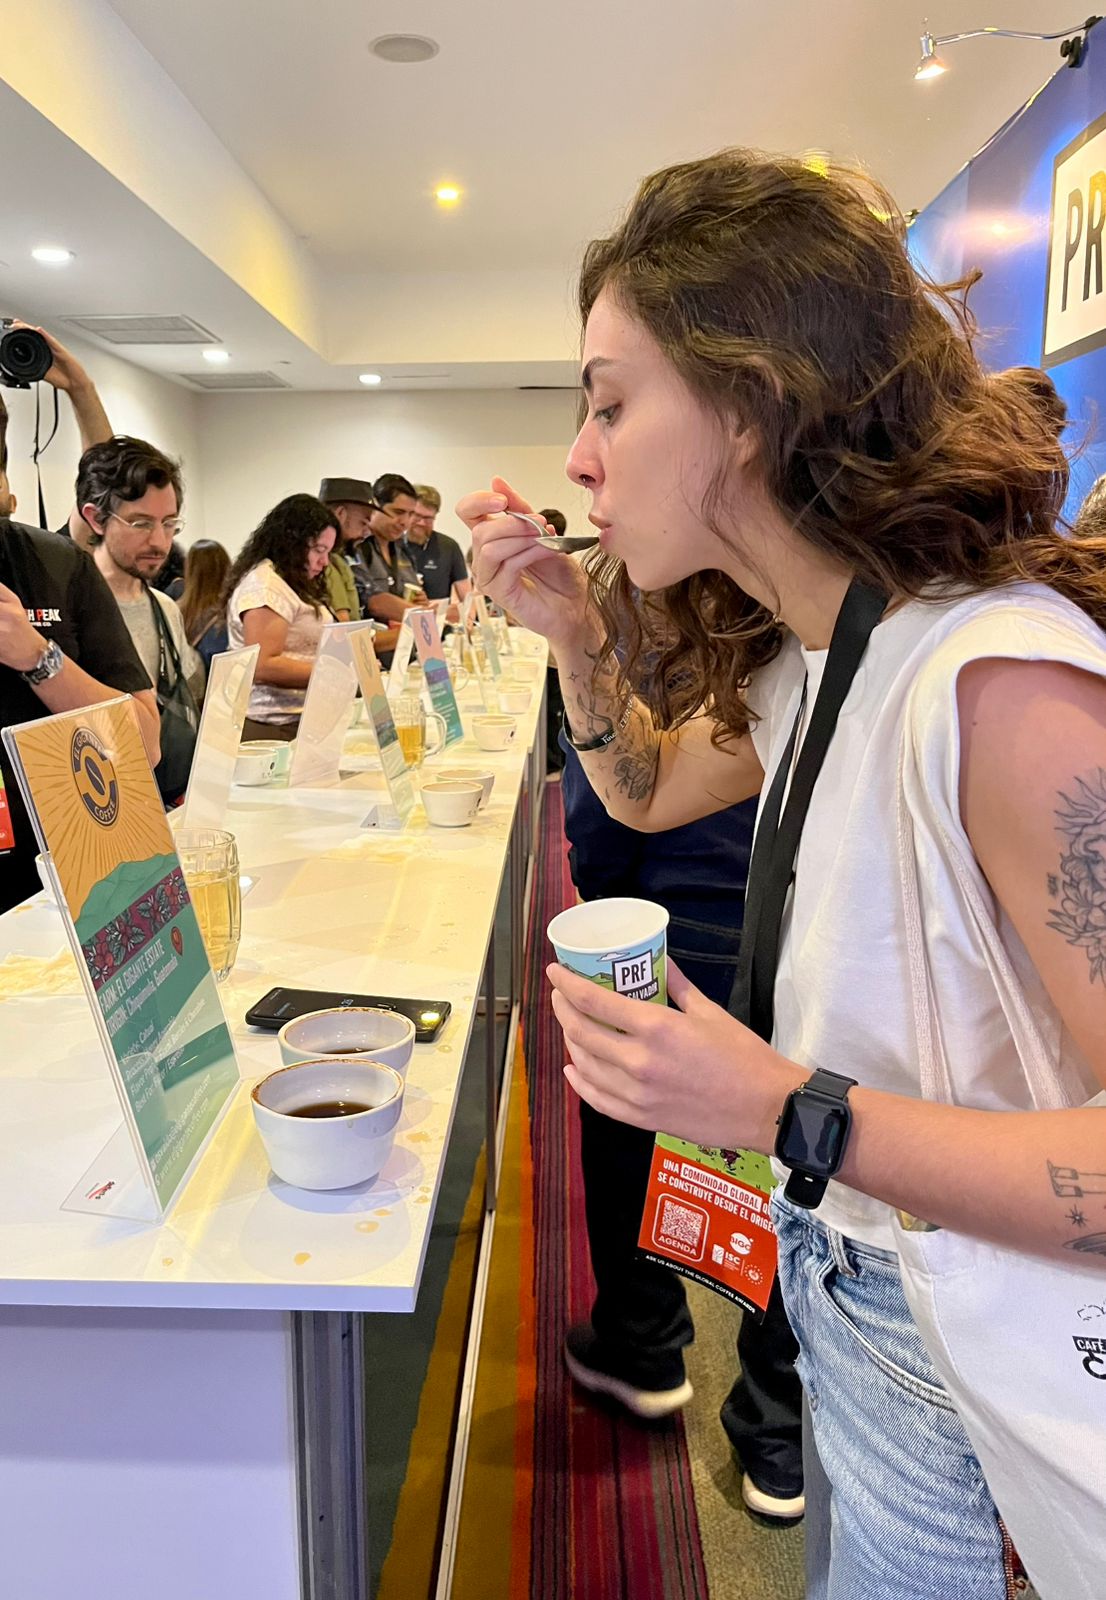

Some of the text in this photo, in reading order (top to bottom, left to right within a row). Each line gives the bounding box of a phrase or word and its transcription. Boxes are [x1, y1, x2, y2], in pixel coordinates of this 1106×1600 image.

[37, 608, 61, 622] PEAK
[115, 976, 126, 998] EL
[144, 938, 165, 969] ESTATE
[621, 960, 647, 986] PRF
[657, 1171, 668, 1184] SE
[668, 1176, 713, 1204] CONSTRUYE
[714, 1192, 739, 1214] DESDE
[739, 1206, 749, 1221] EL
[663, 1158, 680, 1174] UNA
[683, 1166, 730, 1194] COMUNIDAD
[729, 1187, 760, 1210] GLOBAL
[658, 1234, 698, 1257] AGENDA
[725, 1251, 741, 1266] ISC
[657, 1257, 665, 1266] US
[665, 1261, 684, 1273] ABOUT
[684, 1269, 695, 1278] THE
[715, 1284, 735, 1299] COFFEE
